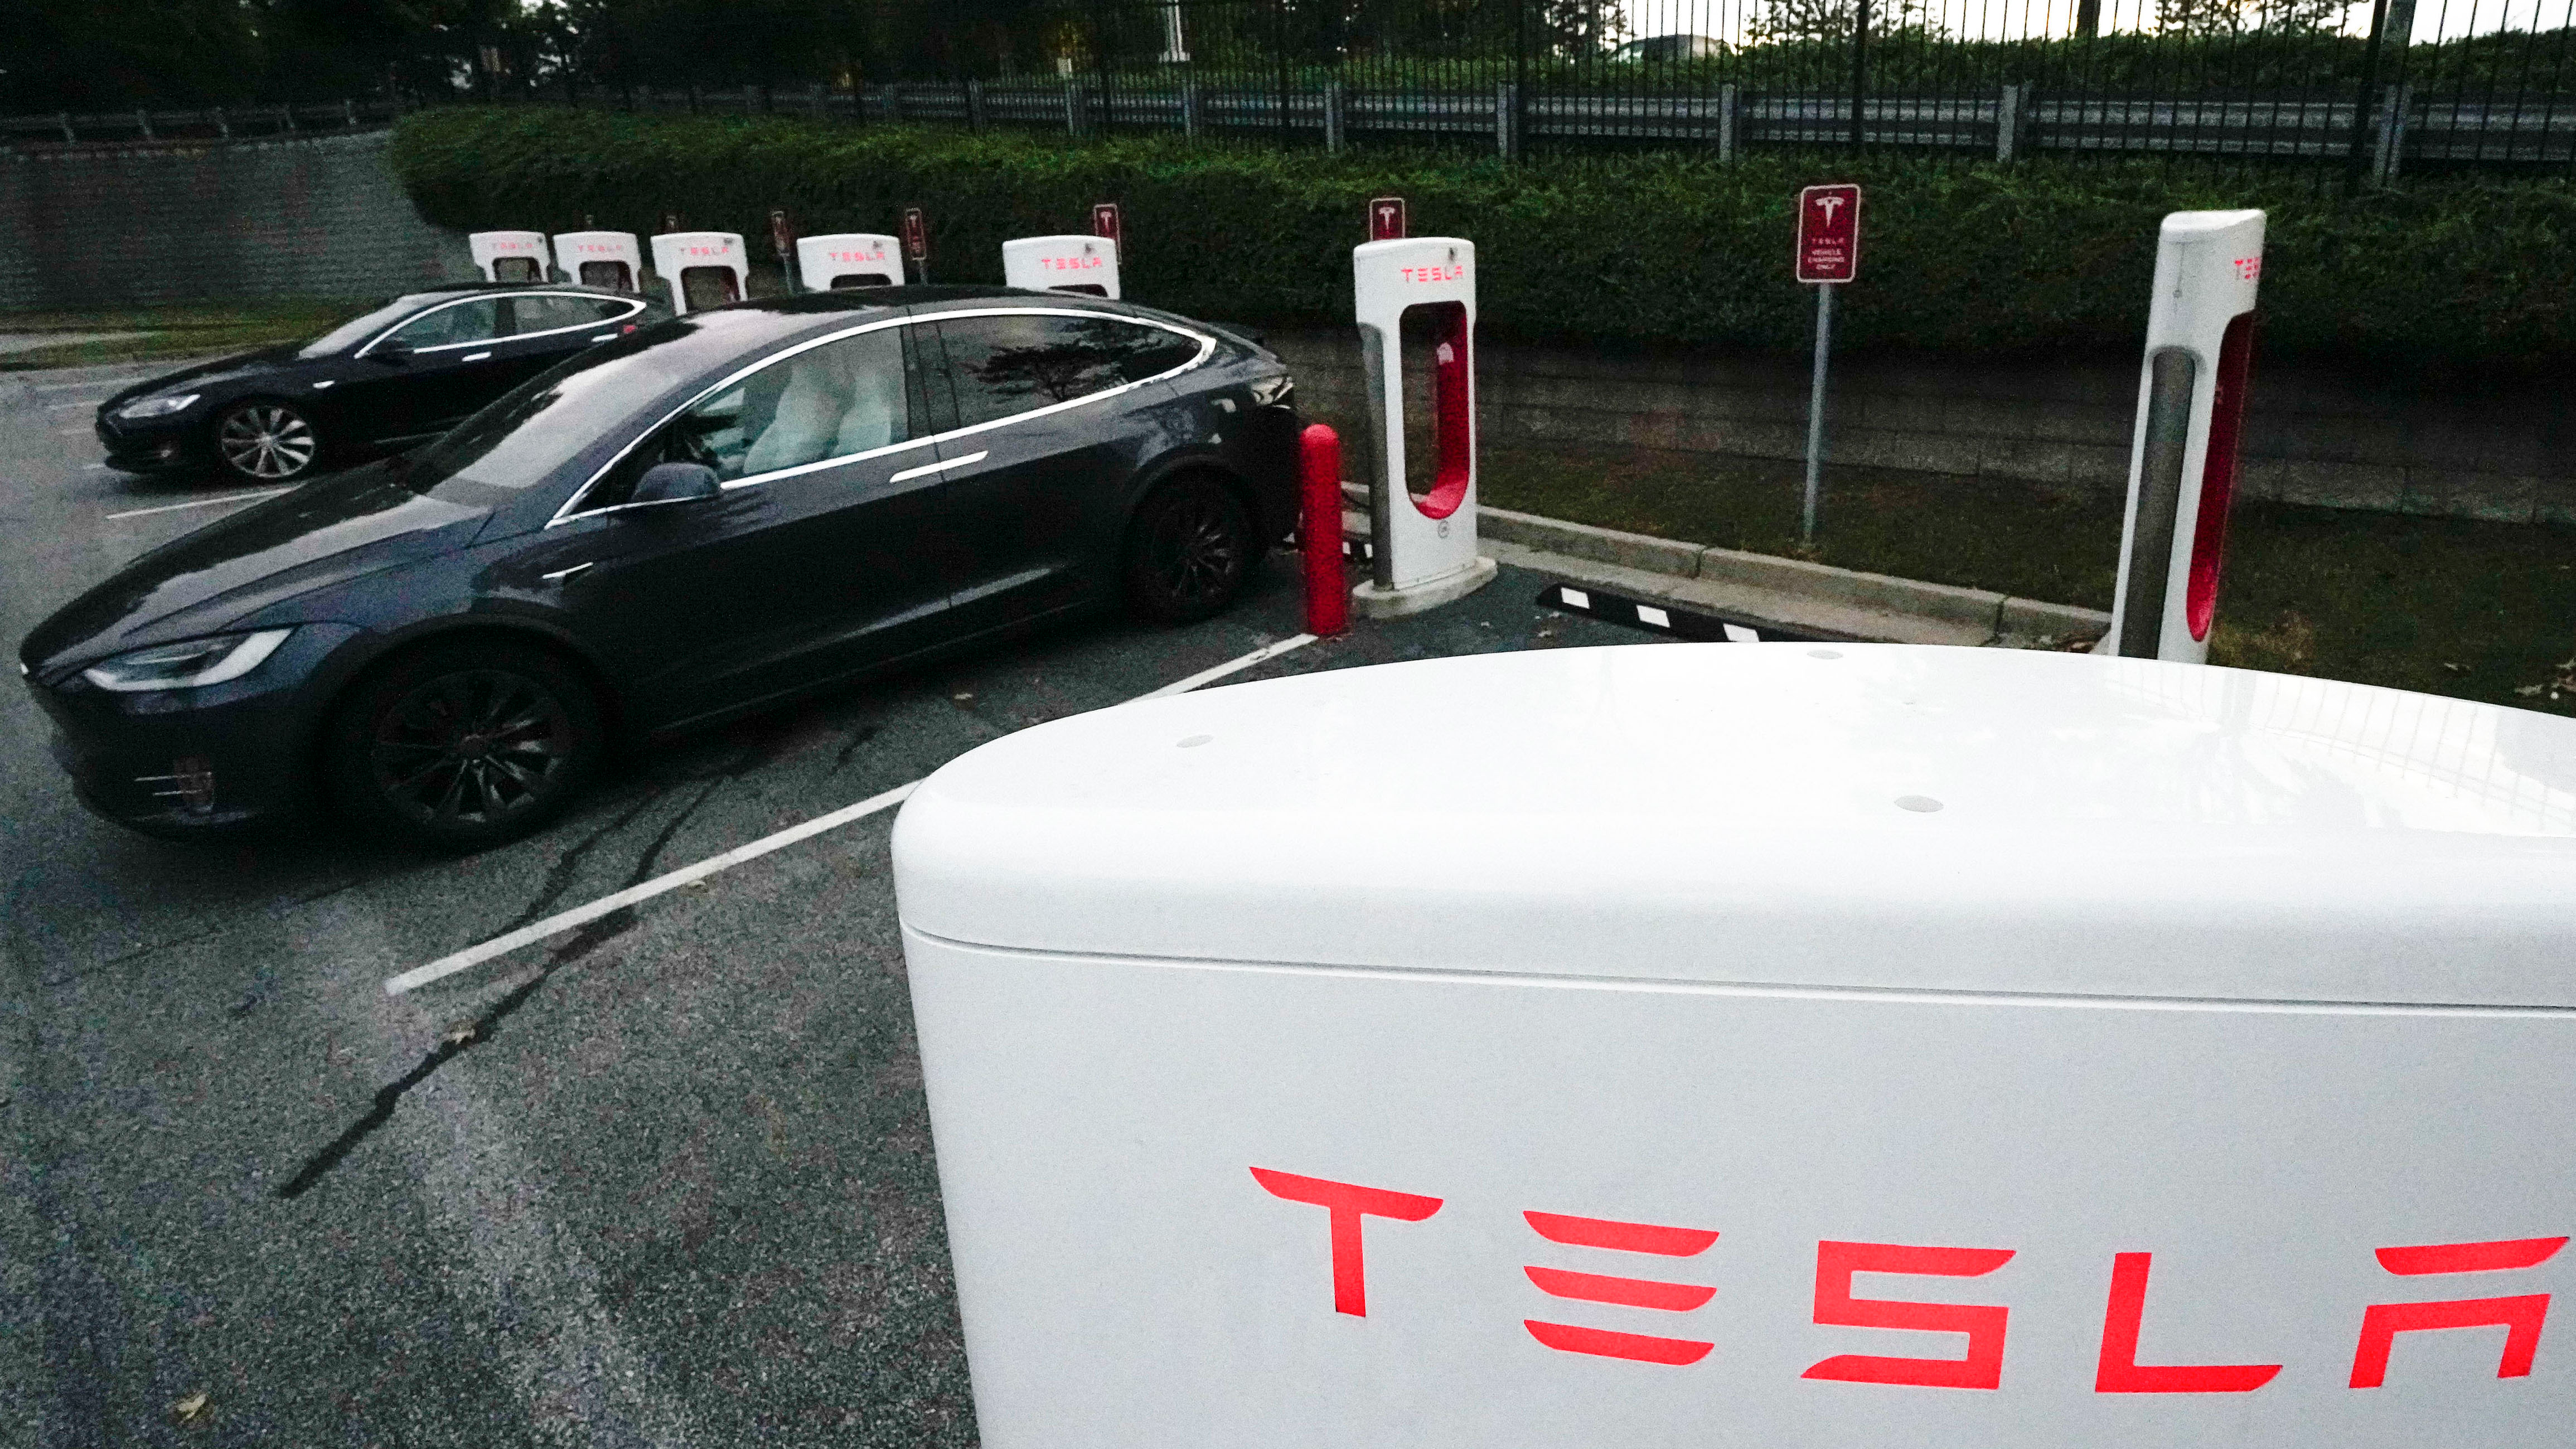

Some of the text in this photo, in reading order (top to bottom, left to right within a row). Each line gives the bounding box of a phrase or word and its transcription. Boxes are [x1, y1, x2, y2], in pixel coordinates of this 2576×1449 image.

[1041, 256, 1103, 271] TESLA
[1401, 265, 1464, 283] TESLA
[1248, 1166, 2569, 1393] TESLA
